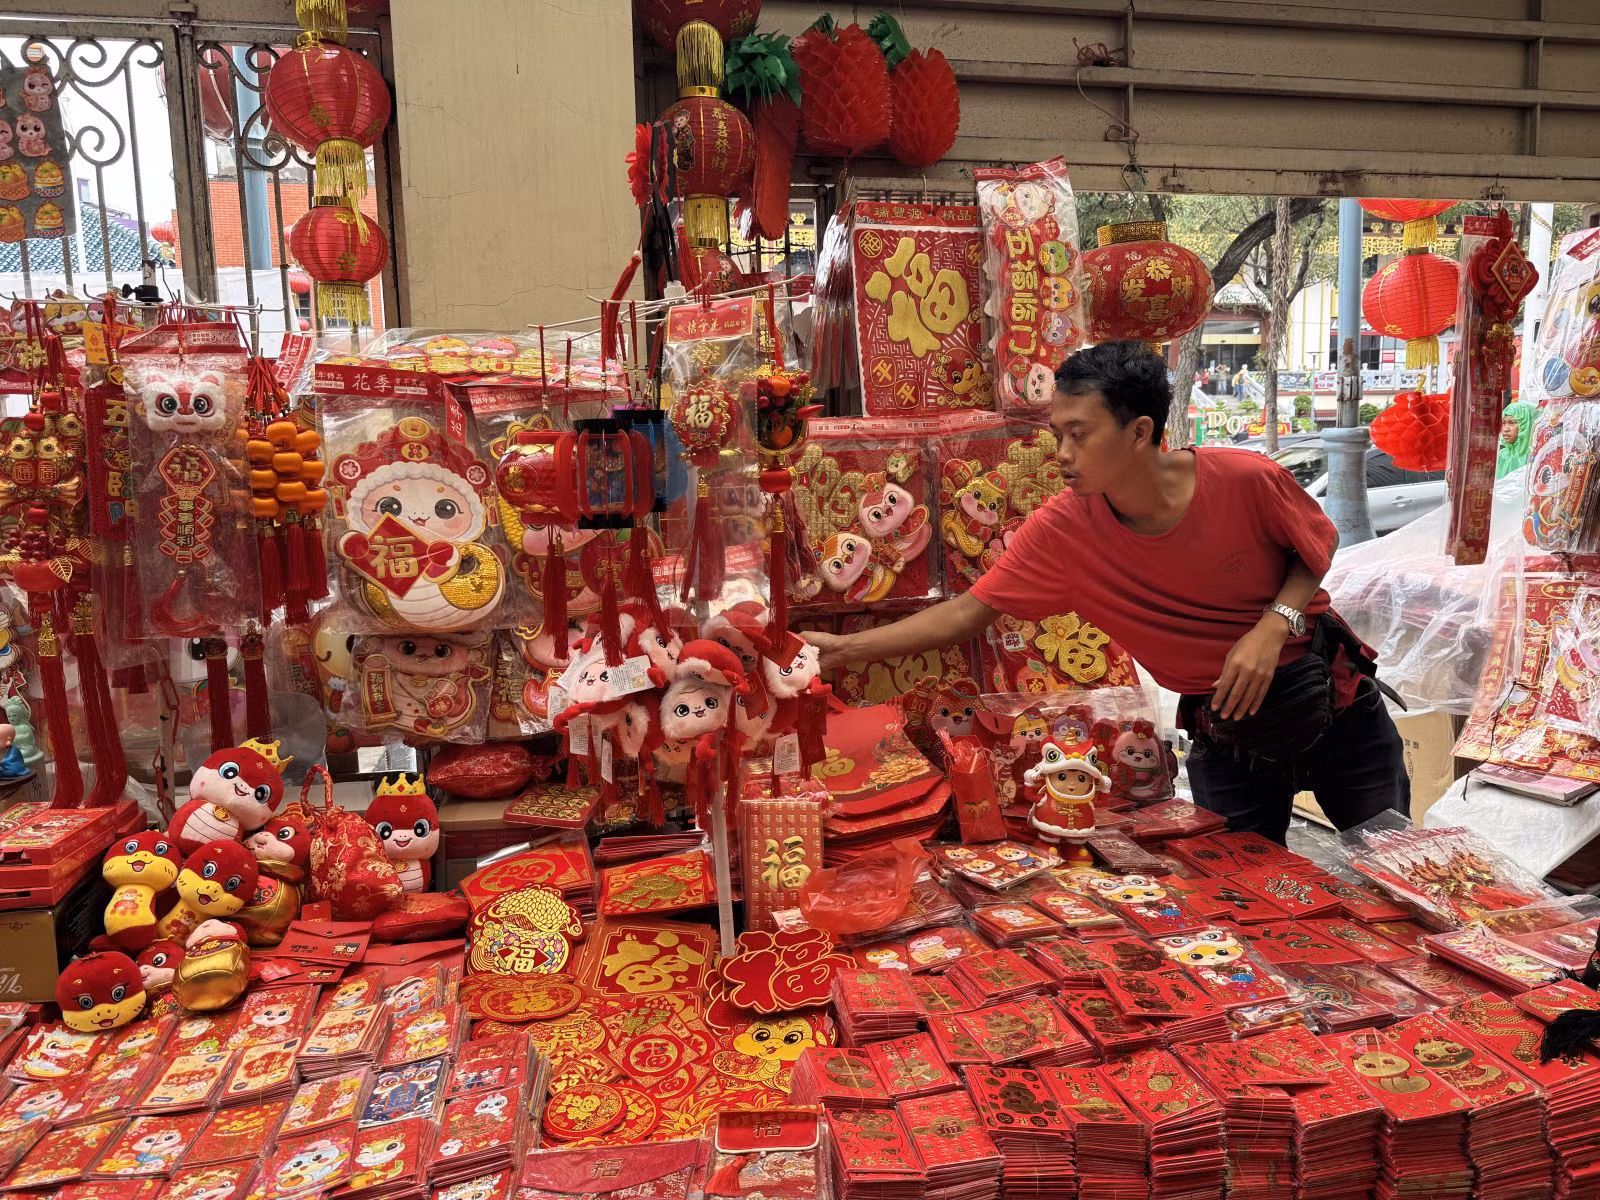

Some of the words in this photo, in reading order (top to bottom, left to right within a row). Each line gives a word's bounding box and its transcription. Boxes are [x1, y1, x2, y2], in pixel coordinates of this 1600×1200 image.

[865, 237, 970, 358] 福
[370, 535, 419, 578] 福
[761, 836, 811, 890] 福
[504, 942, 540, 974] 福
